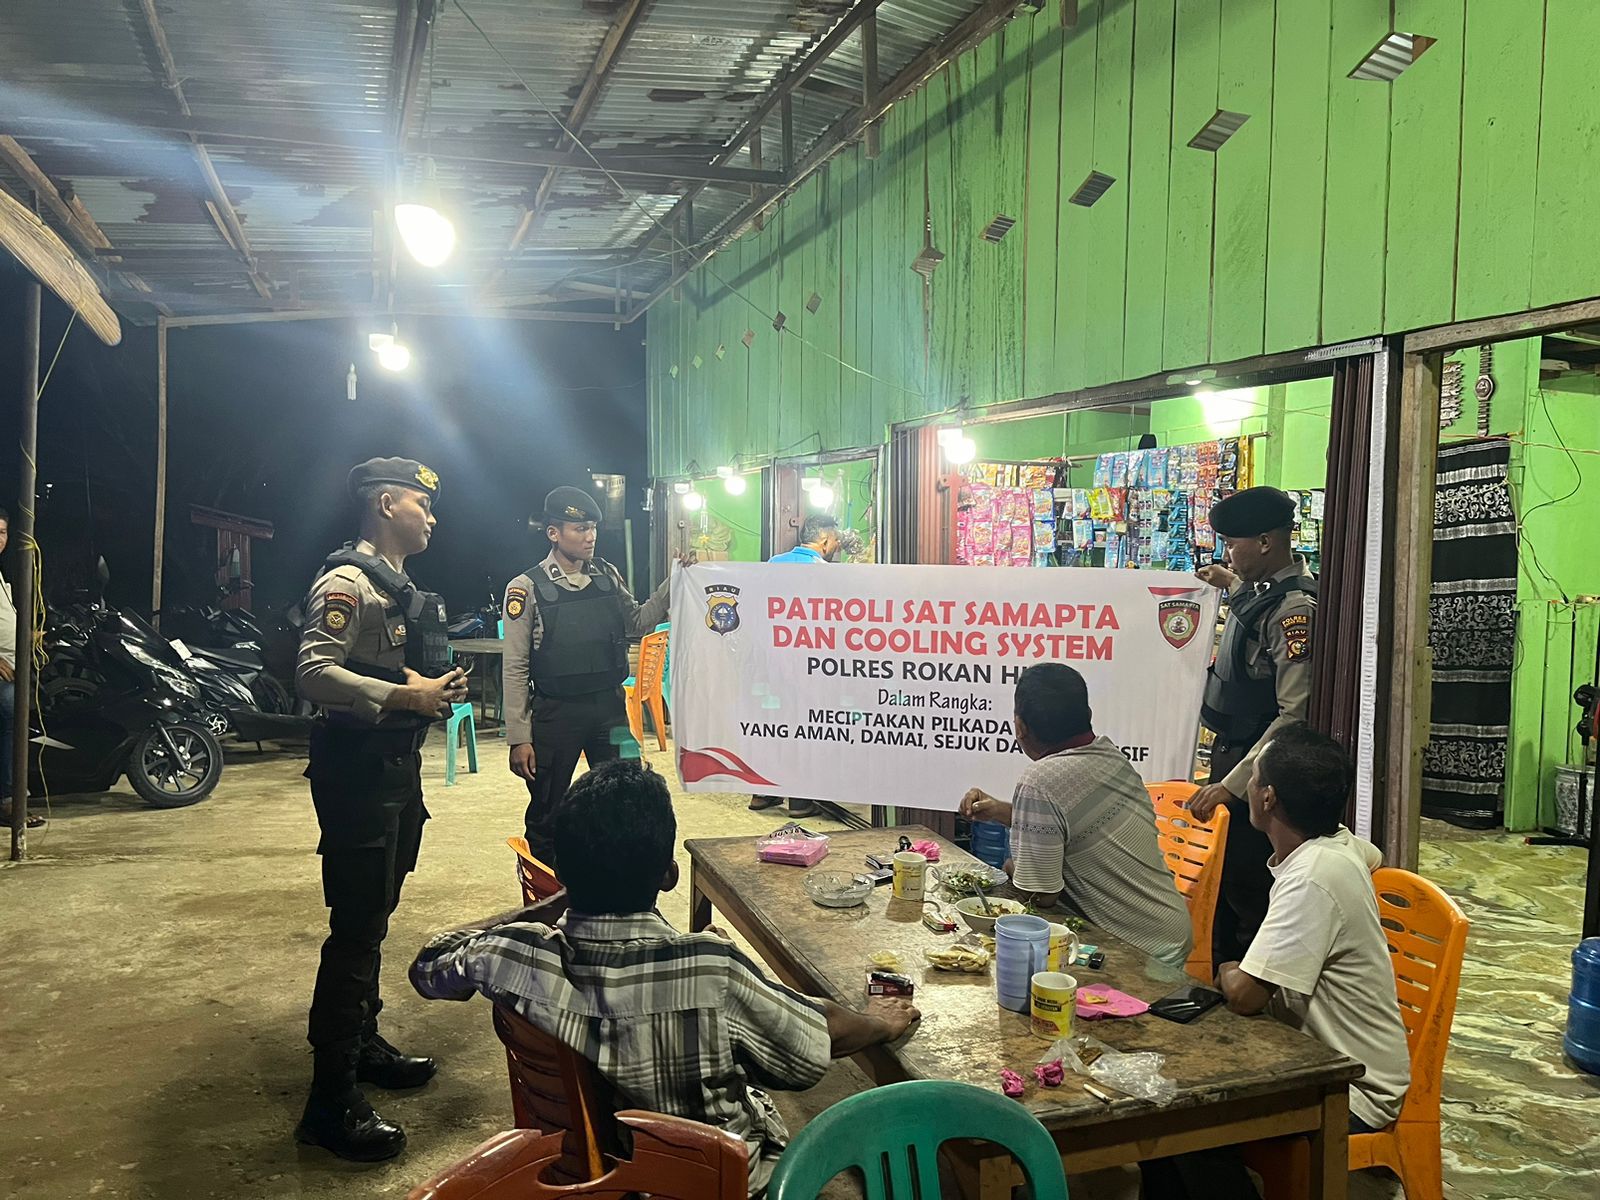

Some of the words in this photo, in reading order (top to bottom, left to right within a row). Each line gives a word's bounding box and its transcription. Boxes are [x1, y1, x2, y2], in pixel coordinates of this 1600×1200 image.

[767, 597, 893, 623] PATROLI
[902, 599, 956, 625] SAT
[964, 601, 1120, 630] SAMAPTA
[772, 625, 836, 650] DAN
[844, 627, 987, 656] COOLING
[996, 631, 1113, 661] SYSTEM
[807, 656, 894, 680] POLRES
[902, 661, 991, 684] ROKAN
[1001, 665, 1027, 685] H
[878, 688, 925, 708] Dalam
[929, 691, 992, 715] Rangka:
[808, 709, 925, 730] MECIPTAKAN
[931, 716, 1013, 736] PILKADA
[740, 722, 789, 739] YANG
[794, 725, 855, 745] AMAN,
[861, 729, 928, 750] DAMAI,
[934, 734, 990, 752] SEJUK
[995, 738, 1024, 755] DA
[1115, 745, 1149, 762] SIF
